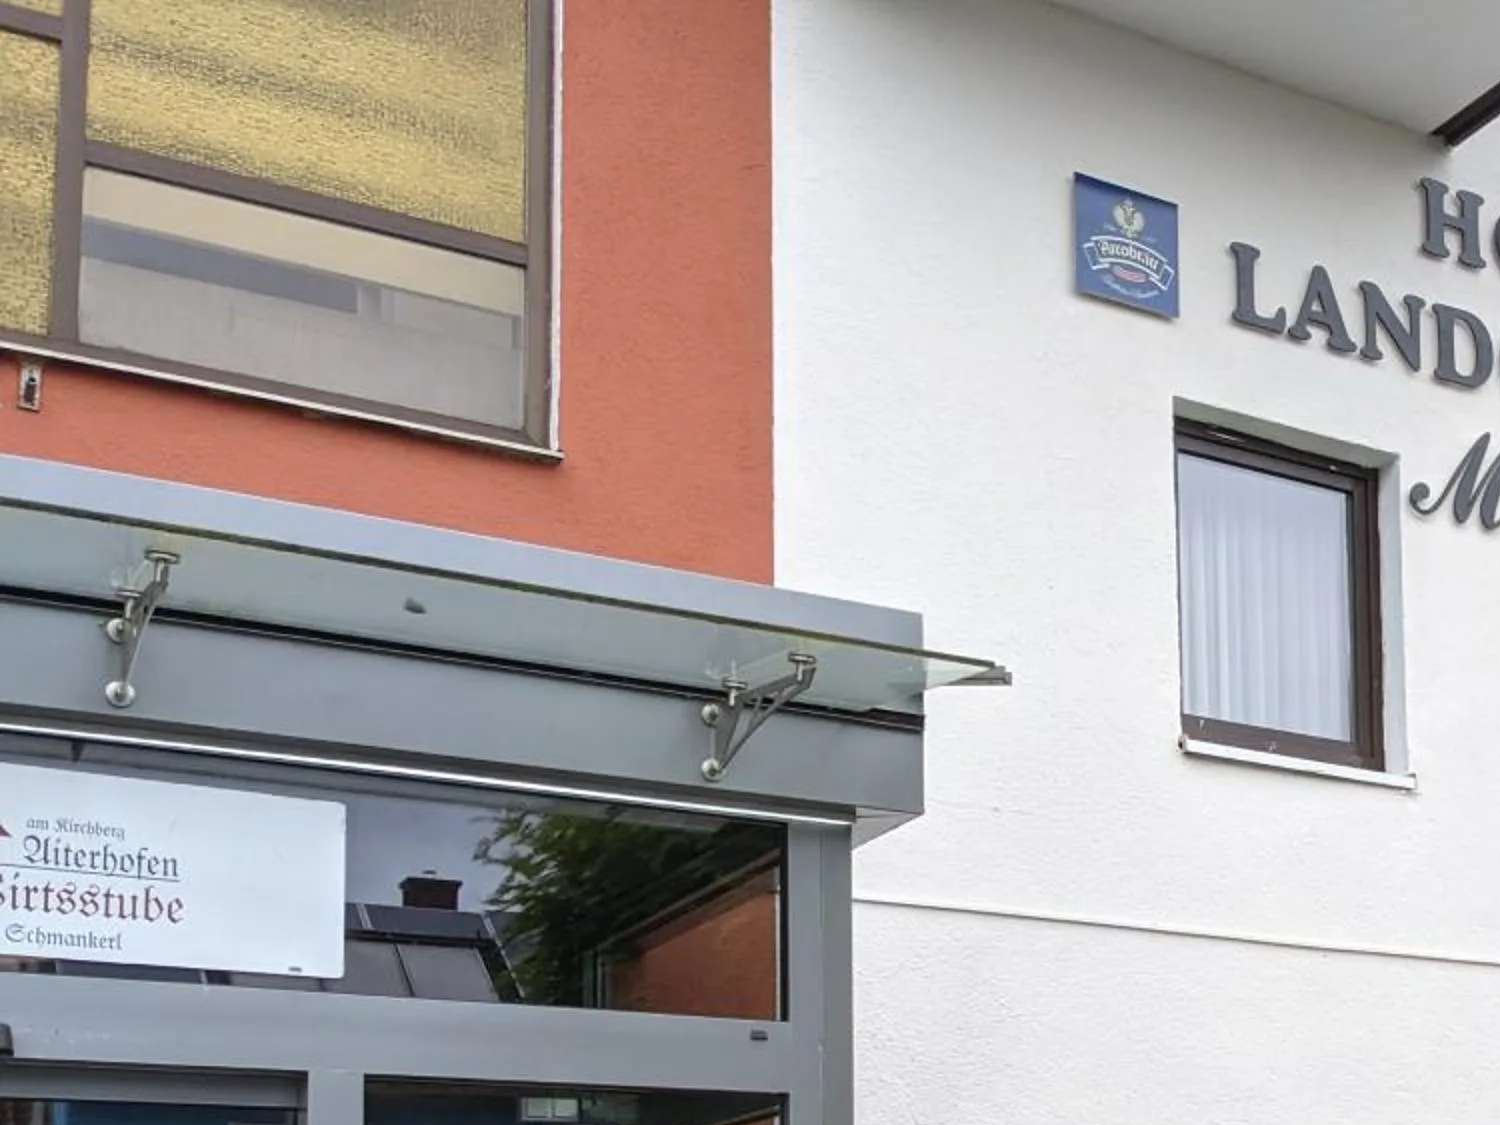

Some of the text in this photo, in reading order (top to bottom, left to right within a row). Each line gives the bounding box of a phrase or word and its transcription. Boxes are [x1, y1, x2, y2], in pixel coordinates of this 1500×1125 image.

[26, 817, 126, 841] am Kirchberg
[23, 835, 180, 879] Aiterhofen
[0, 871, 184, 925] irtsstube
[5, 922, 123, 951] Schmankerl
